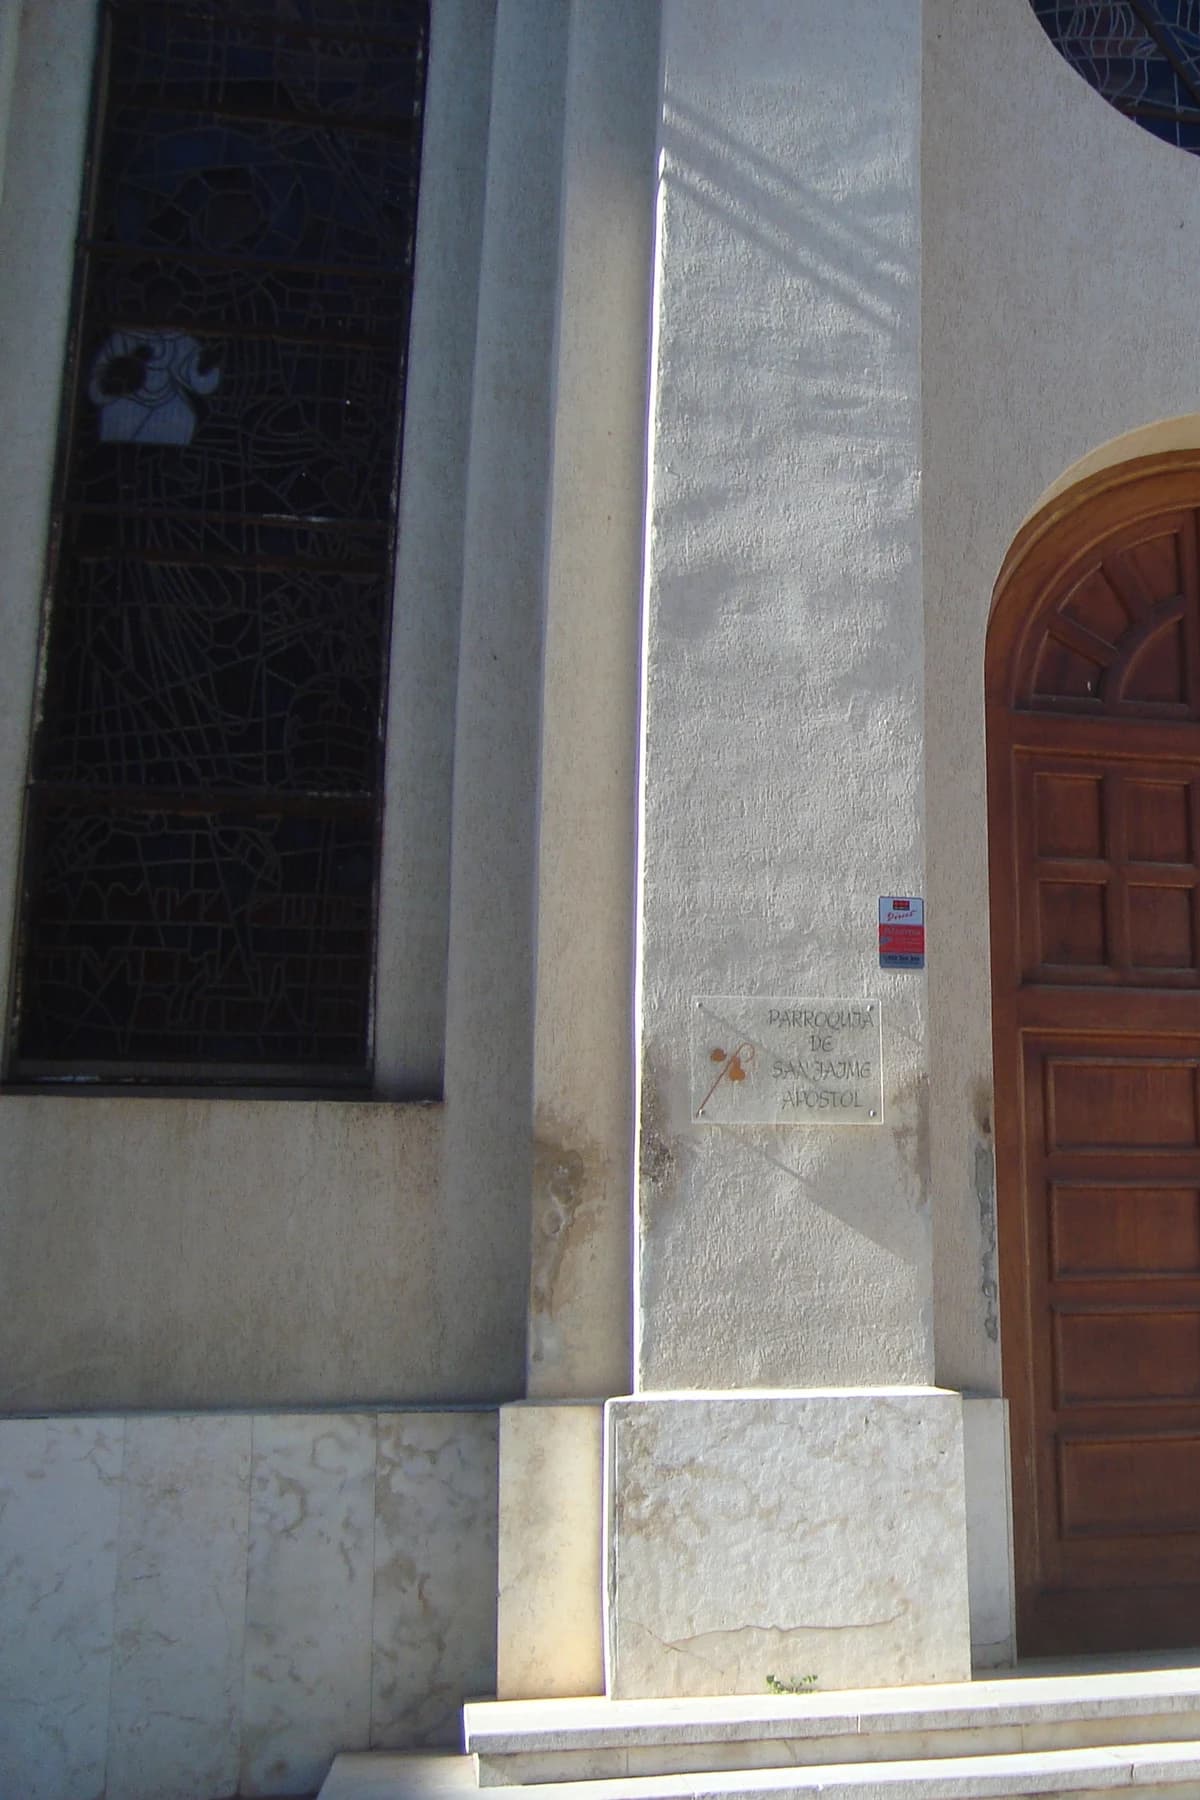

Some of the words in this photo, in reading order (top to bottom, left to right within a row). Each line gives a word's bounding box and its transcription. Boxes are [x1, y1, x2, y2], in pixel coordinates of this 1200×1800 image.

[768, 1008, 874, 1029] PARROQUIA
[809, 1034, 834, 1052] DE
[772, 1060, 808, 1080] SAN
[812, 1060, 872, 1081] JAIME
[781, 1089, 864, 1110] APOSTOL
